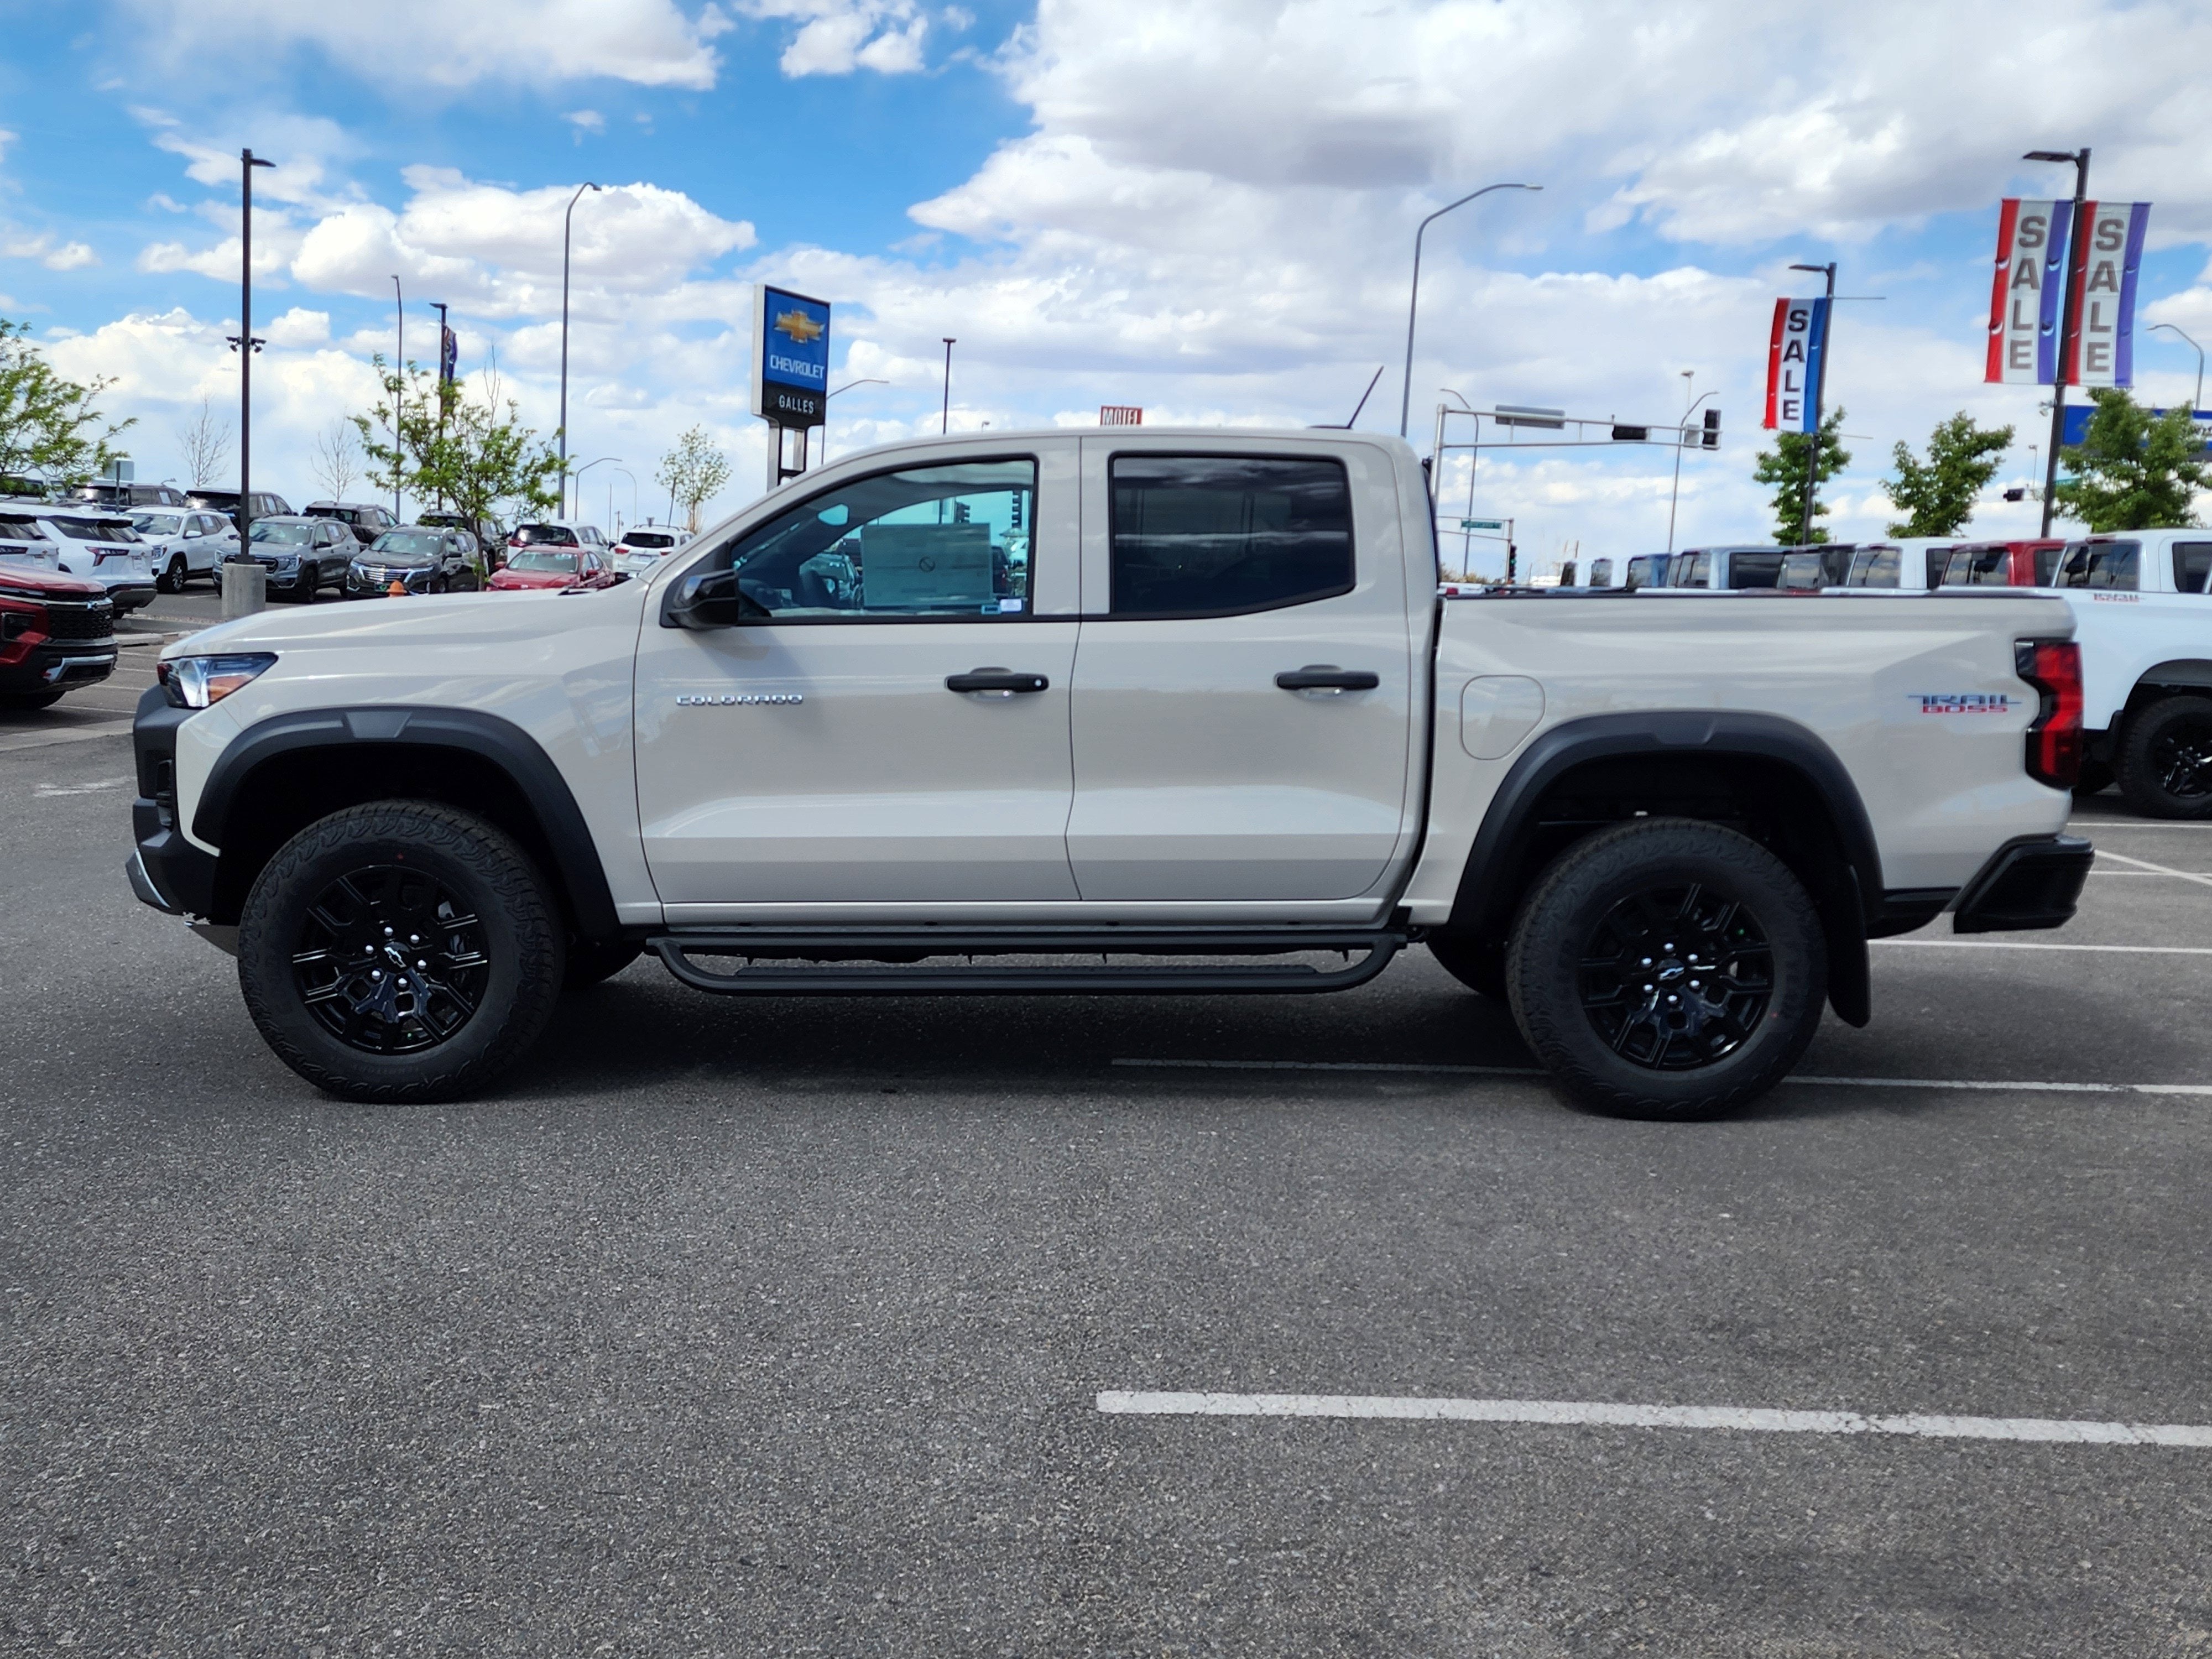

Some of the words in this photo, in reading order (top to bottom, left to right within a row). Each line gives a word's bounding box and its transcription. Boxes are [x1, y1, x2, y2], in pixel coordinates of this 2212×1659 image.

[2010, 216, 2047, 370] SALE
[2086, 218, 2125, 372] SALE
[770, 353, 825, 380] CHEVROLET
[1783, 309, 1809, 420] SALE
[779, 395, 814, 415] GALLES
[676, 694, 803, 706] COLORADO
[1907, 695, 2022, 705] TRAIL
[1923, 705, 2008, 713] BOSS
